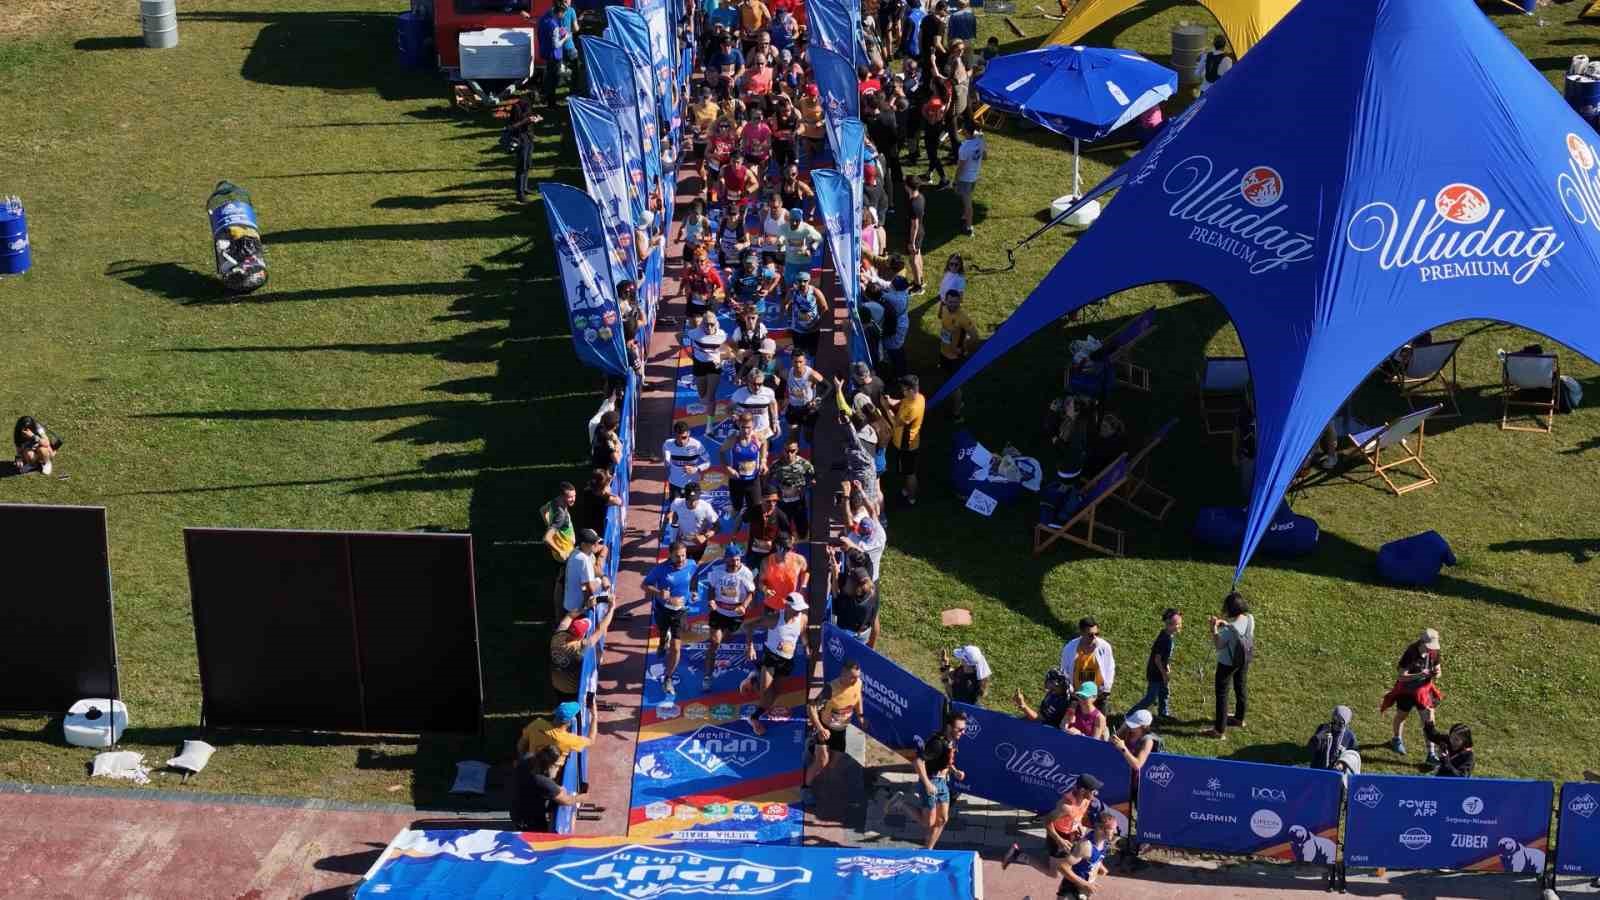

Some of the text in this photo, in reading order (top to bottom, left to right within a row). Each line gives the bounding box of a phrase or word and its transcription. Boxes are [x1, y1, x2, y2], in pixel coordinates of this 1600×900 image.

[1162, 155, 1315, 274] Uludağ
[1188, 225, 1257, 263] PREMIUM
[1347, 198, 1565, 284] Uludağ
[1419, 261, 1511, 282] PREMIUM
[862, 673, 908, 709] NADOLU
[688, 739, 758, 754] UPUT
[1149, 771, 1170, 780] UPUT
[1251, 786, 1287, 801] DOCA
[1357, 793, 1378, 801] UPUT
[1398, 799, 1437, 809] POWER
[1190, 811, 1237, 824] GARMIN
[1414, 808, 1437, 817] APP
[580, 863, 777, 883] UPUT
